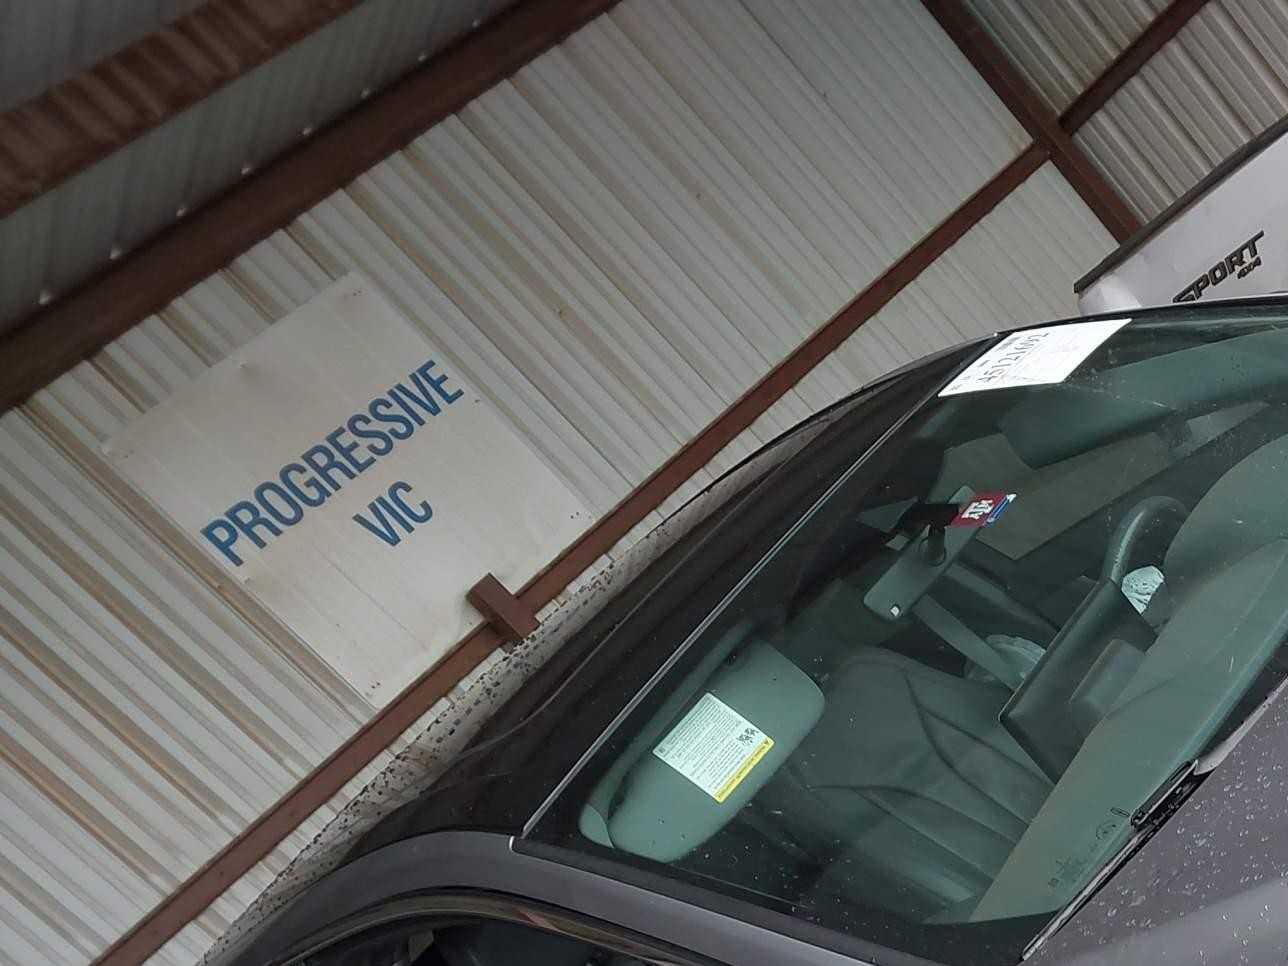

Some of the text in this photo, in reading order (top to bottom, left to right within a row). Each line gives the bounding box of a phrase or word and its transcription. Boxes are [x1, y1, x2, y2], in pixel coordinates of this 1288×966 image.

[1172, 229, 1265, 303] SPORT
[200, 360, 465, 567] PROGRESSIVE
[353, 481, 433, 548] VIC
